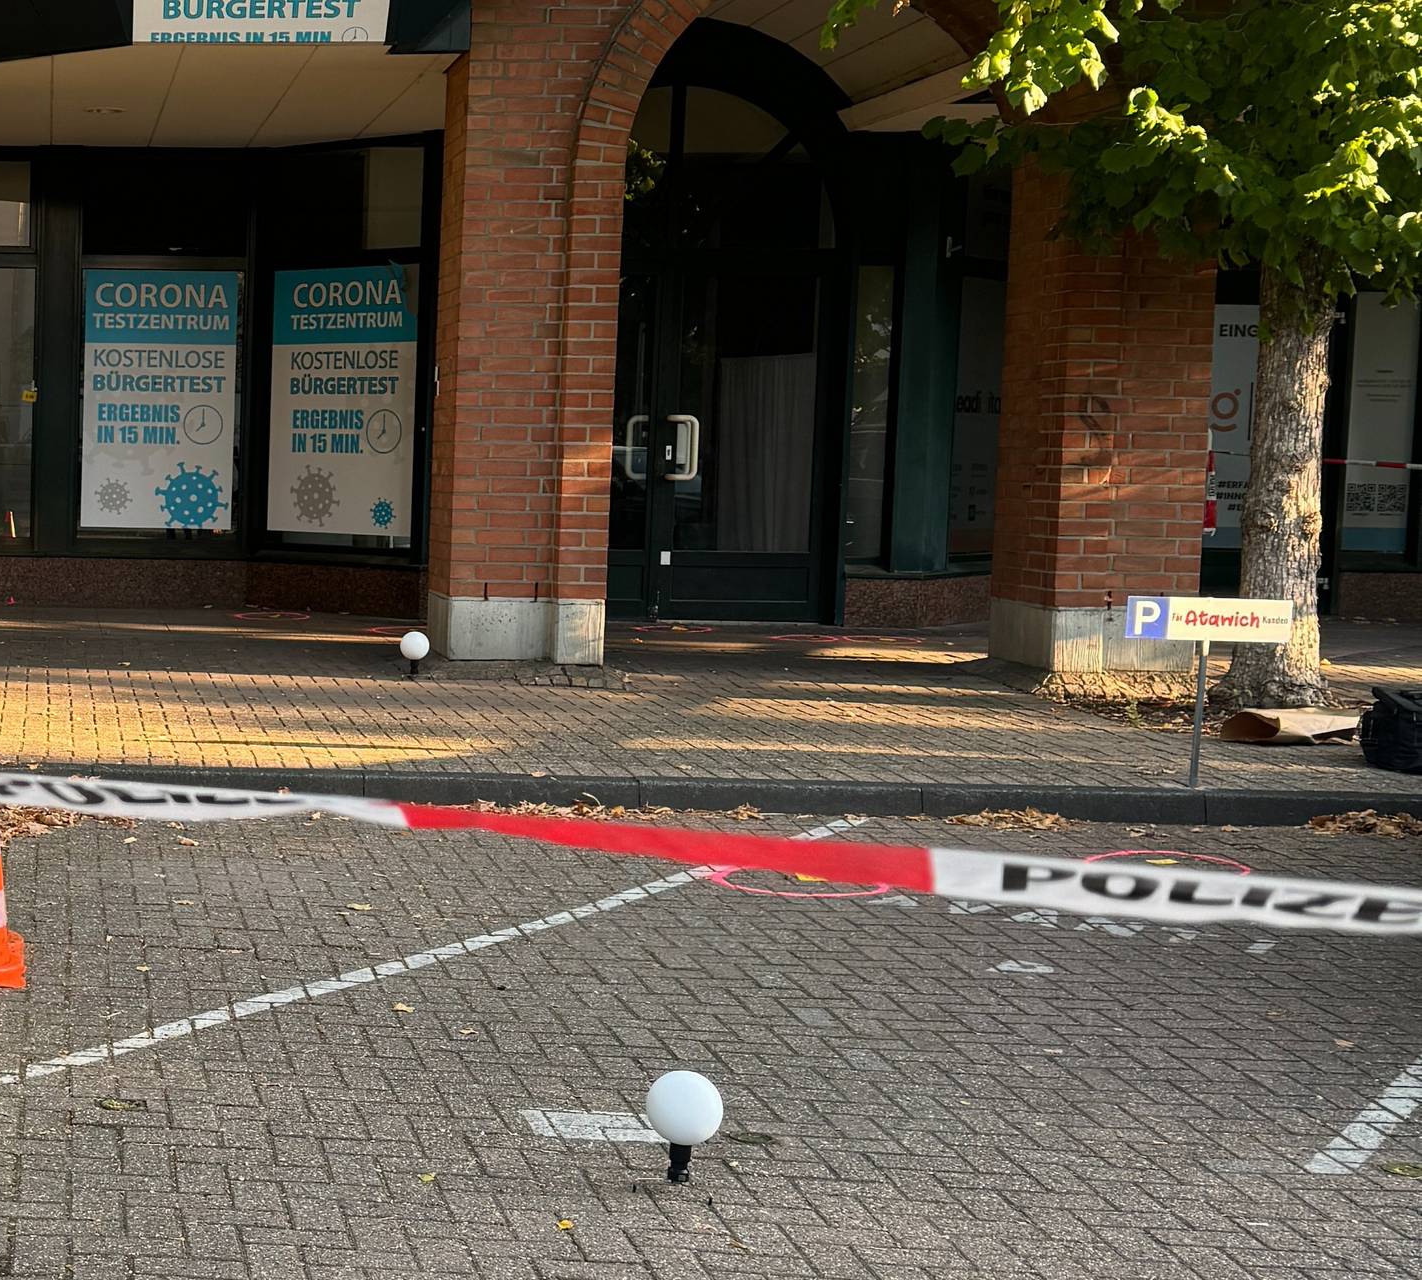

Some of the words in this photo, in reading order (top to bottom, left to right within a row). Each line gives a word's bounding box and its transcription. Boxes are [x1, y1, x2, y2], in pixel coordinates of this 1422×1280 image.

[94, 281, 229, 310] CORONA
[292, 279, 403, 309] CORONA
[92, 313, 230, 331] TESTZENTRUM
[290, 311, 404, 330] TESTZENTRUM
[1219, 323, 1259, 338] EING
[92, 348, 225, 369] KOSTENLOSE
[289, 350, 399, 371] KOSTENLOSE
[92, 371, 226, 393] BÜRGERTEST
[289, 374, 399, 396] BÜRGERTEST
[97, 403, 180, 423] ERGEBNIS
[291, 409, 364, 430] ERGEBNIS
[96, 426, 115, 444] IN
[118, 426, 139, 444] 15
[142, 426, 181, 446] MIN.
[291, 433, 307, 454] IN
[310, 433, 327, 454] 15
[330, 434, 364, 454] MIN.
[1217, 480, 1250, 489] #ERFA
[1133, 600, 1162, 635] P
[1184, 609, 1261, 629] Atawich
[1000, 861, 1422, 924] POLIZE
